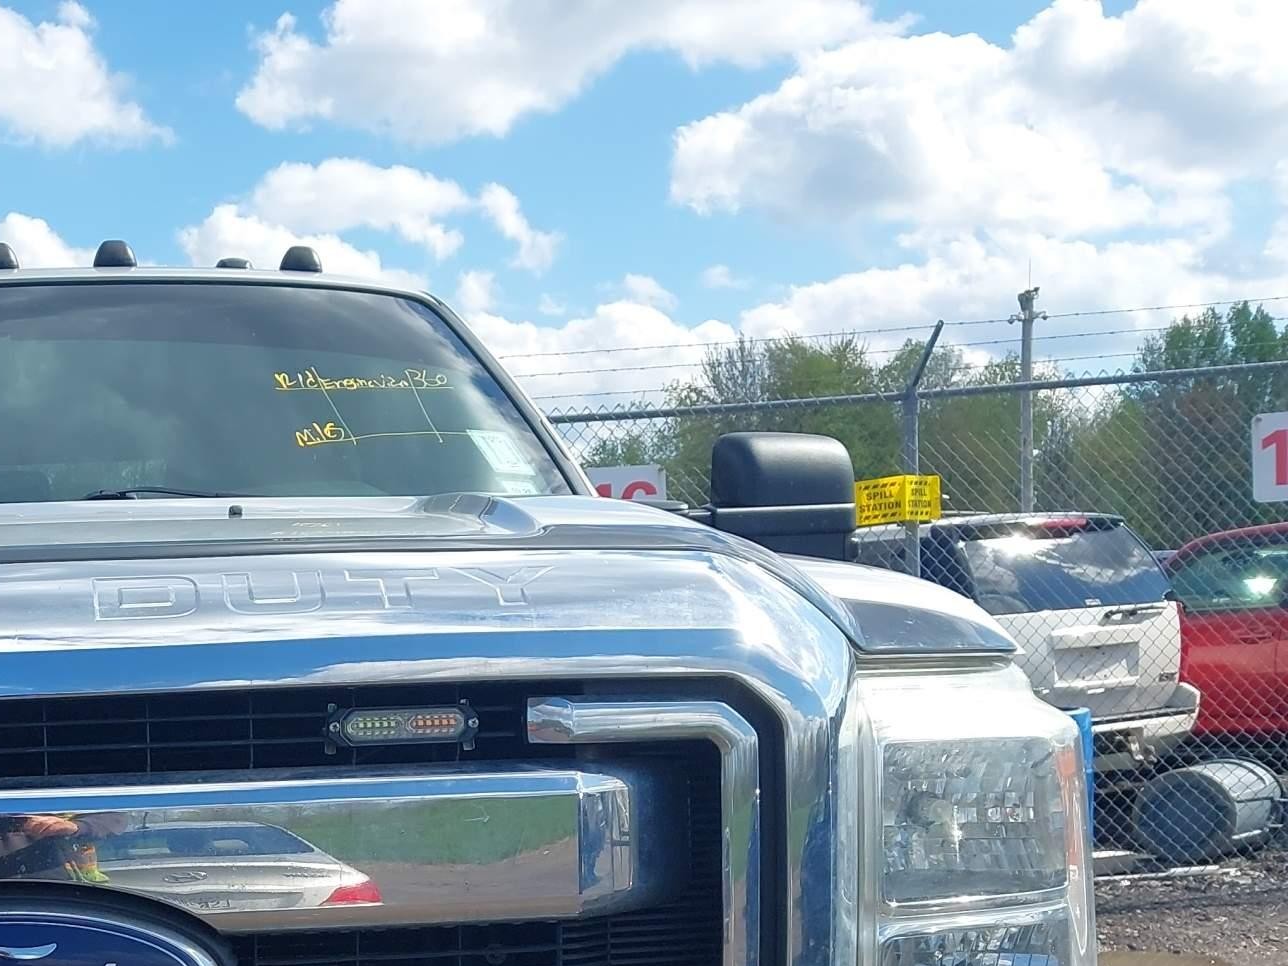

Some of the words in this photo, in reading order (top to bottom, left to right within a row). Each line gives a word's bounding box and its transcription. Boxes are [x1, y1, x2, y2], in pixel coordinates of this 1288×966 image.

[866, 489, 895, 501] SPILL
[911, 487, 928, 497] SPILL
[859, 500, 902, 514] STATION
[907, 499, 932, 508] STATION
[90, 565, 555, 622] DUTY
